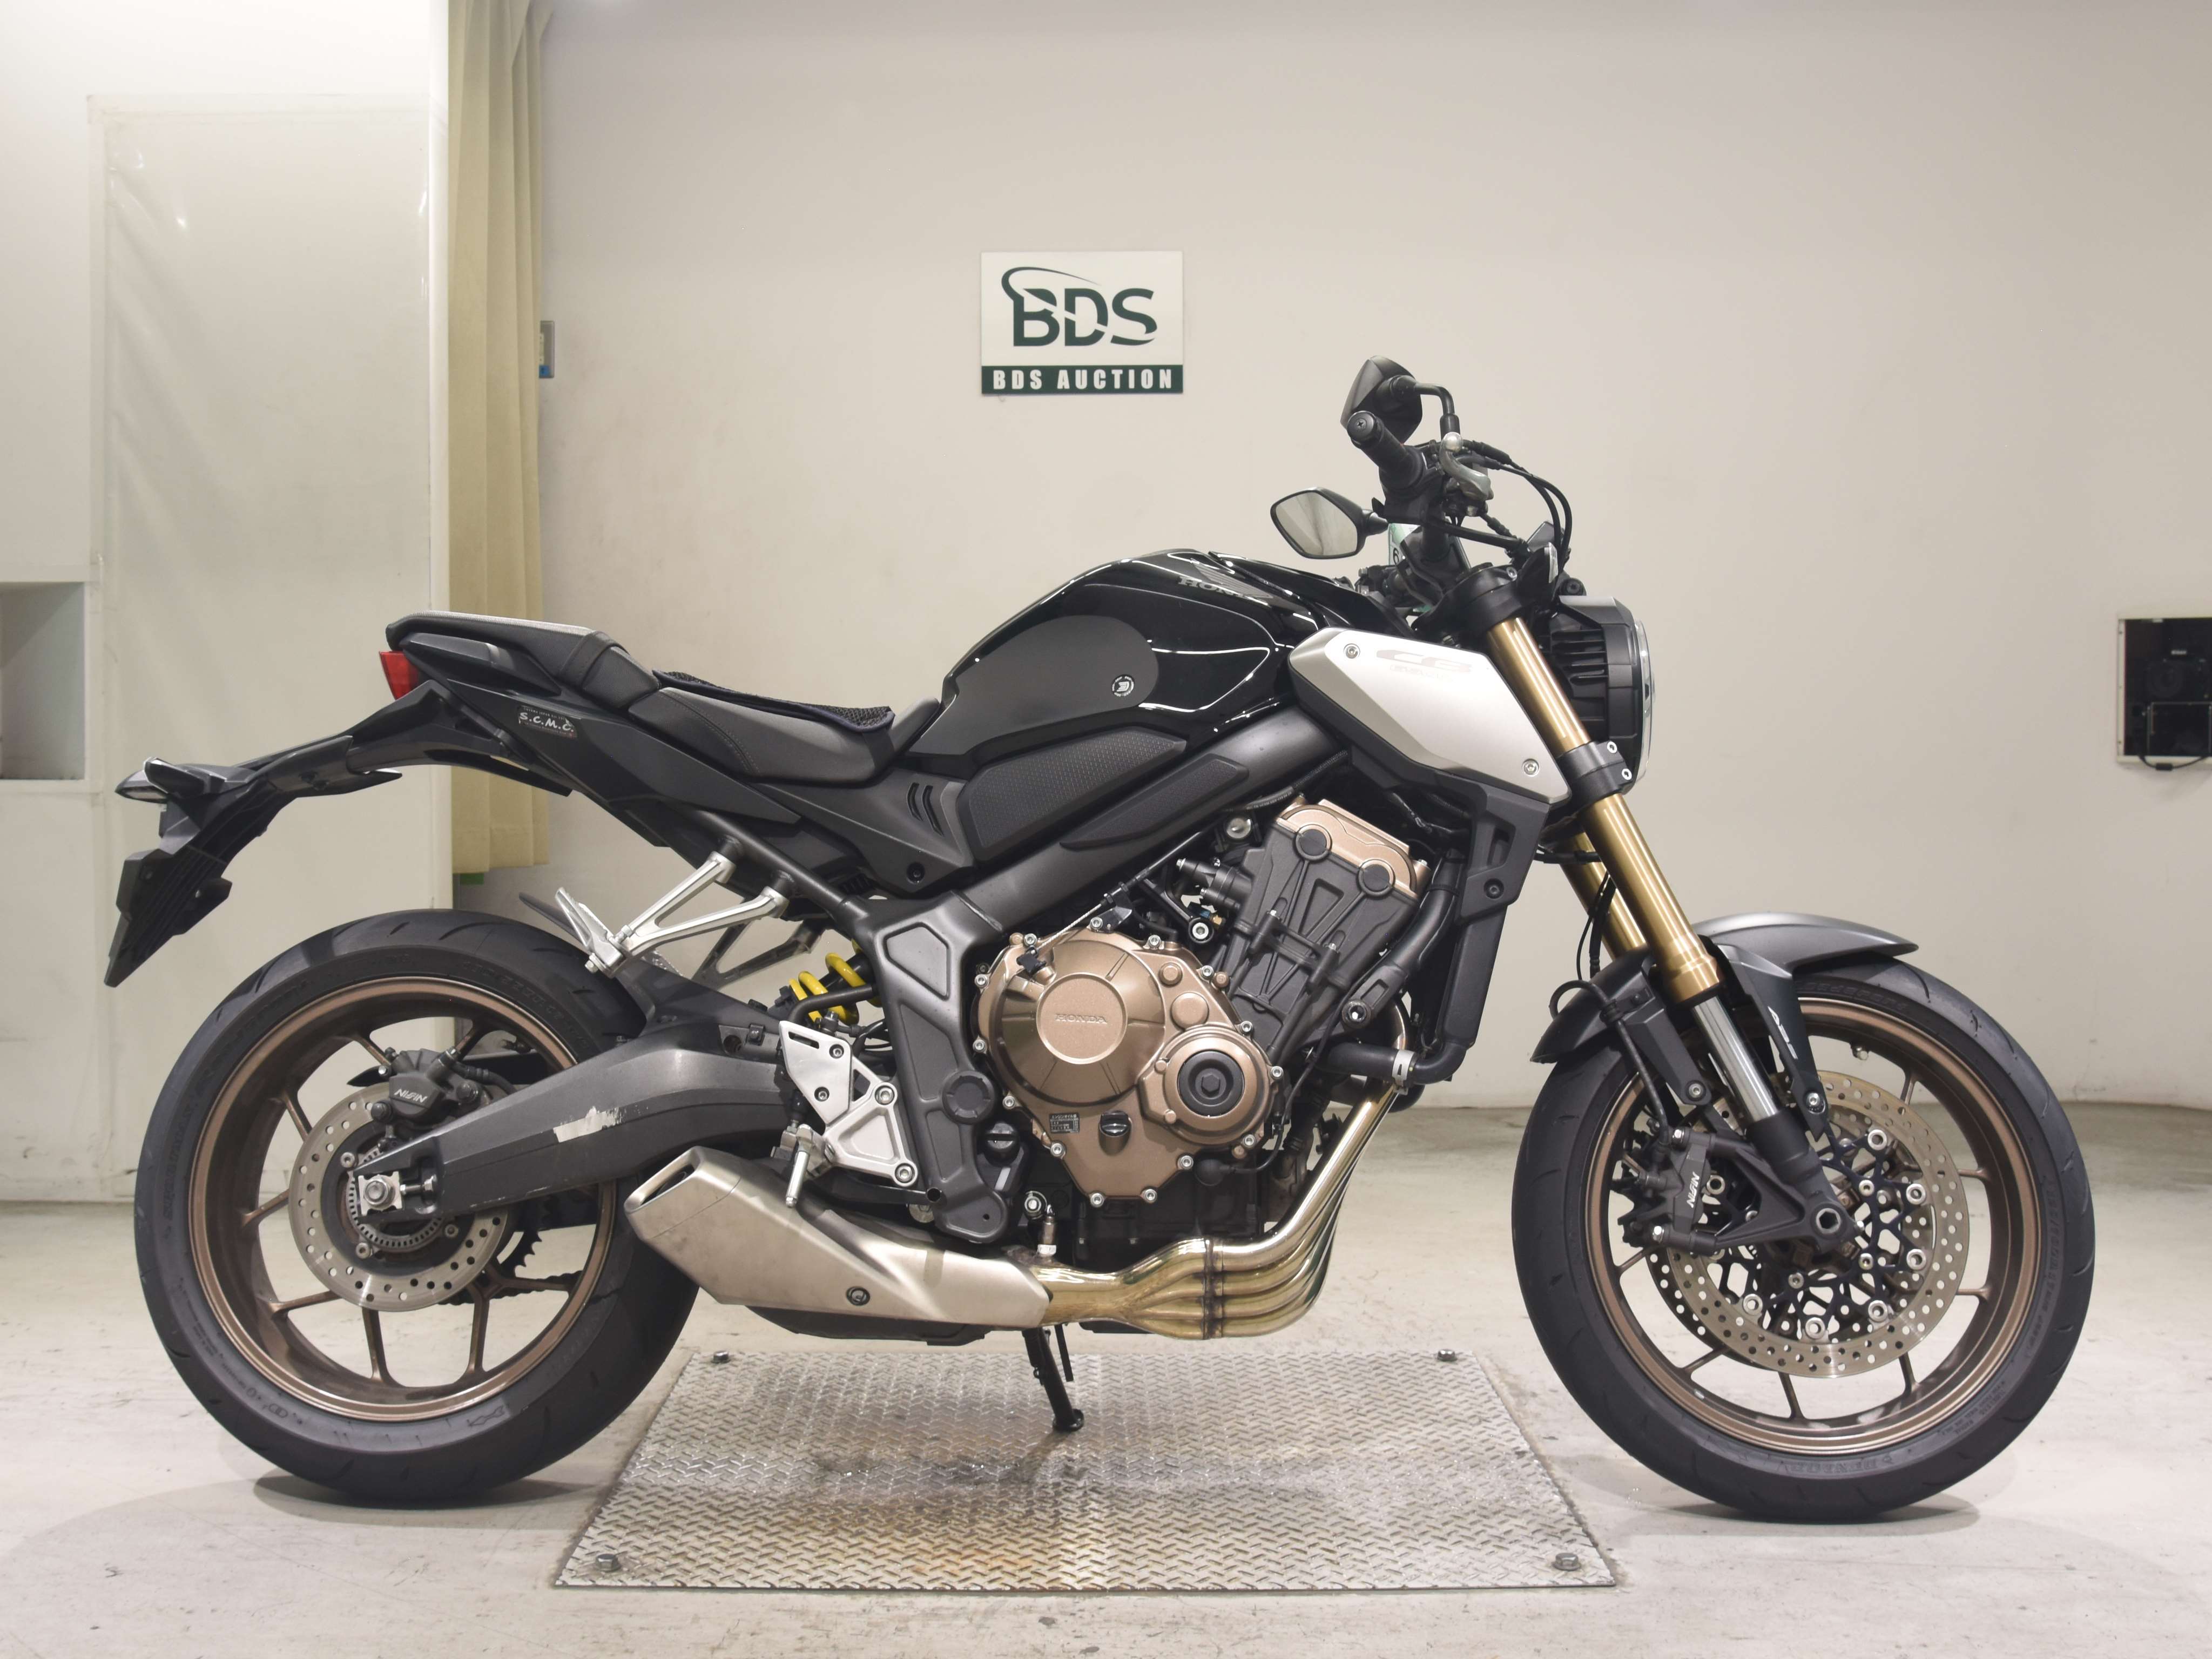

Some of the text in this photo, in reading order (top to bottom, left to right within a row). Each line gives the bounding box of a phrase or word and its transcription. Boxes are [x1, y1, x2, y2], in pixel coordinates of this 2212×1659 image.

[1001, 266, 1157, 346] BDS
[993, 369, 1172, 389] BDS AUCTION
[1054, 1013, 1107, 1024] HONDA
